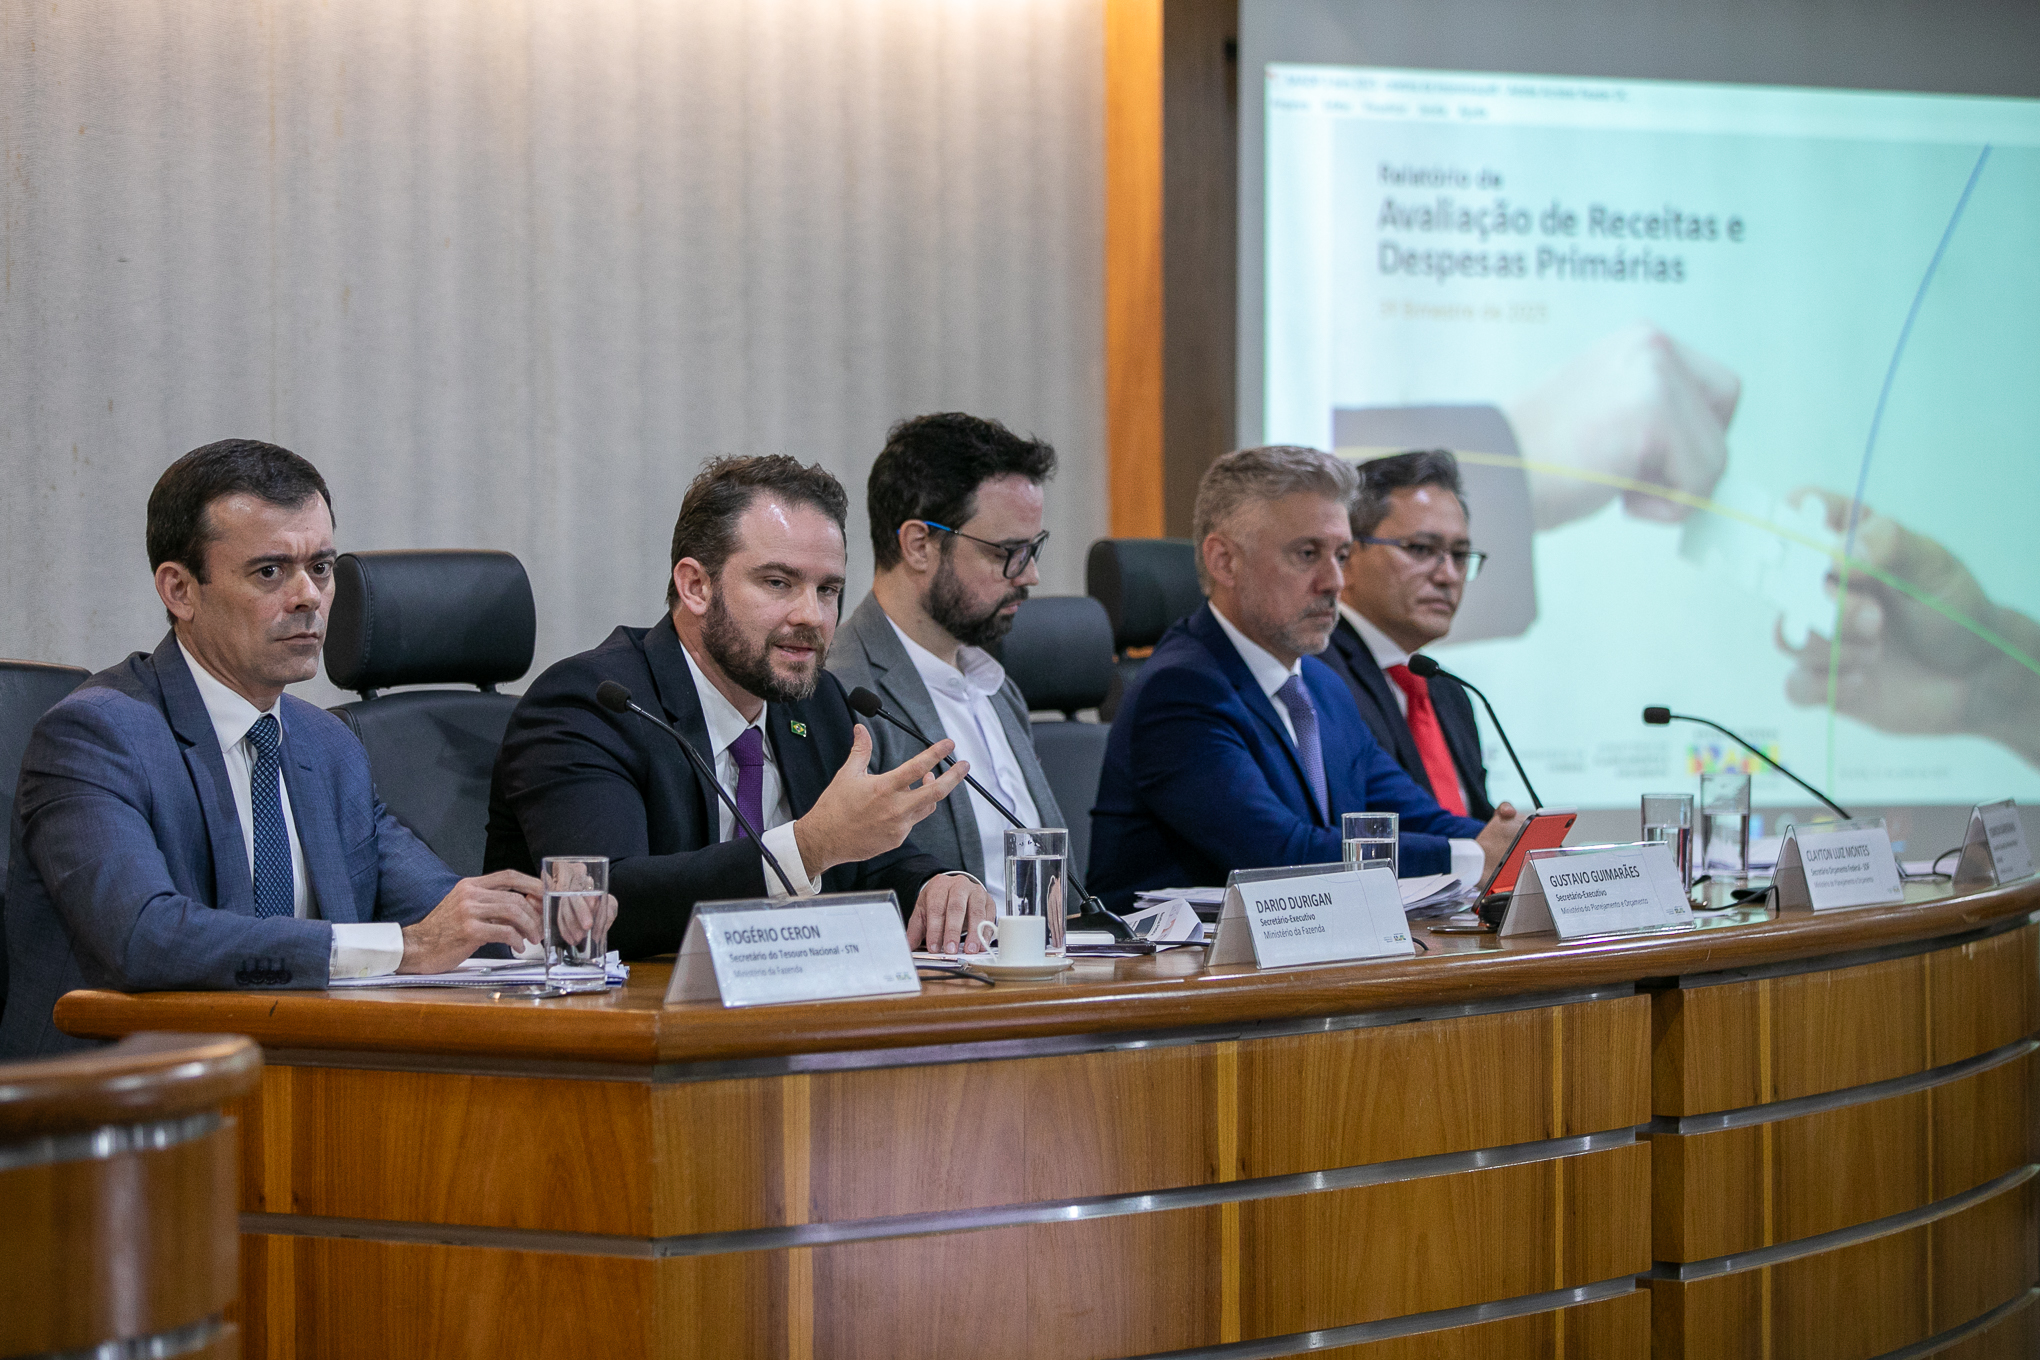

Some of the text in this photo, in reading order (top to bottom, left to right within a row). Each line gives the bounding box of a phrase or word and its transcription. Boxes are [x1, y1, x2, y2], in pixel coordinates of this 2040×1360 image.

[1378, 197, 1745, 243] Avaliação de Receitas e
[1378, 240, 1685, 284] Despesas Primárias
[1845, 845, 1870, 858] MONTES
[1549, 863, 1640, 888] GUSTAVO GUIMARÃES
[1255, 892, 1332, 914] DARIO DURIGAN
[1555, 888, 1607, 902] Secretário-Executivo
[1260, 912, 1316, 927] Secretário-Executivo
[724, 925, 821, 945] ROGÉRIO CERON
[1263, 923, 1326, 940] Ministério da Fazenda
[729, 951, 767, 963] Secretário
[768, 950, 778, 960] do
[778, 949, 808, 959] Tesouro
[808, 945, 840, 957] Nacional
[844, 944, 860, 954] STN
